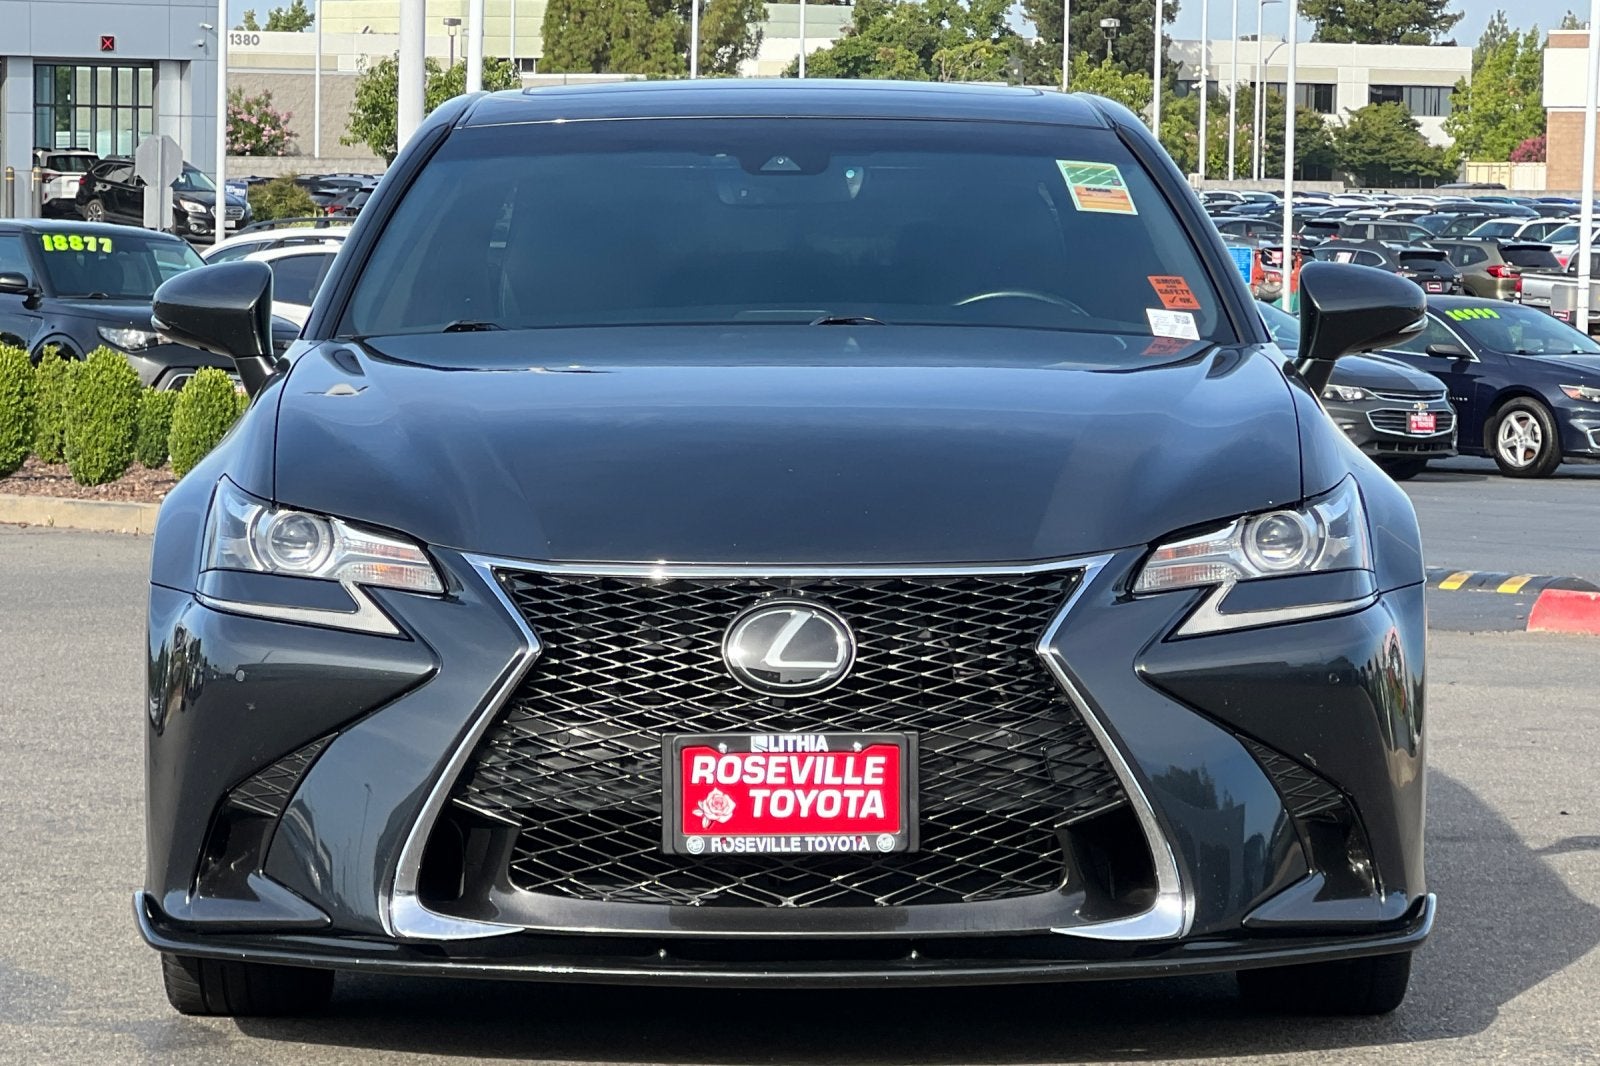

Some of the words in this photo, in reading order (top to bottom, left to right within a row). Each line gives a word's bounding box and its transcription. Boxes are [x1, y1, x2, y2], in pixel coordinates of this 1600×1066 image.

[229, 33, 260, 46] 1380
[42, 234, 112, 253] 18877
[768, 735, 829, 752] LITHIA
[691, 755, 886, 785] ROSEVILLE
[749, 789, 885, 819] TOYOTA
[711, 837, 801, 853] ROSEVILLE
[804, 836, 870, 852] TOYOTA
